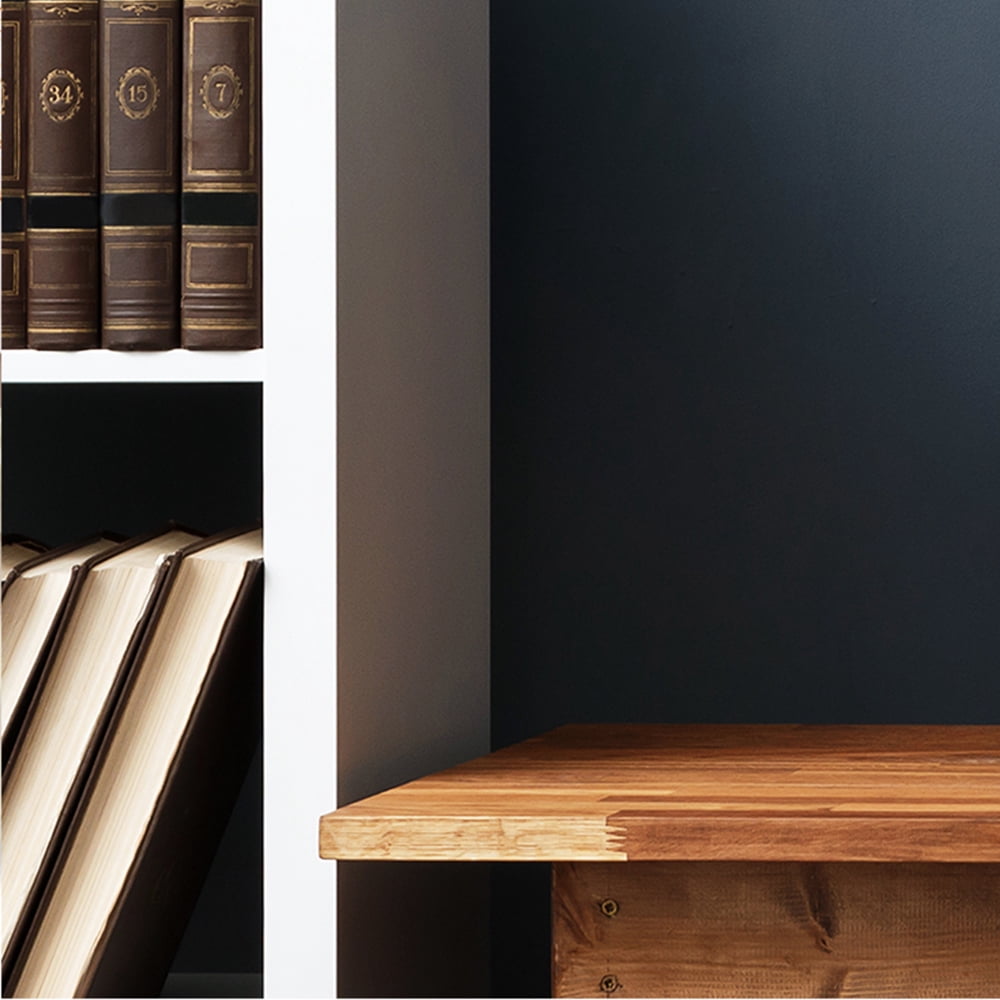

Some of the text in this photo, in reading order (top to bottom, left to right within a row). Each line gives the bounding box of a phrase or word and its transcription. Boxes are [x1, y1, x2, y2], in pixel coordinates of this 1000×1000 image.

[49, 85, 74, 104] 34
[128, 84, 148, 103] 15
[215, 82, 228, 102] 7
